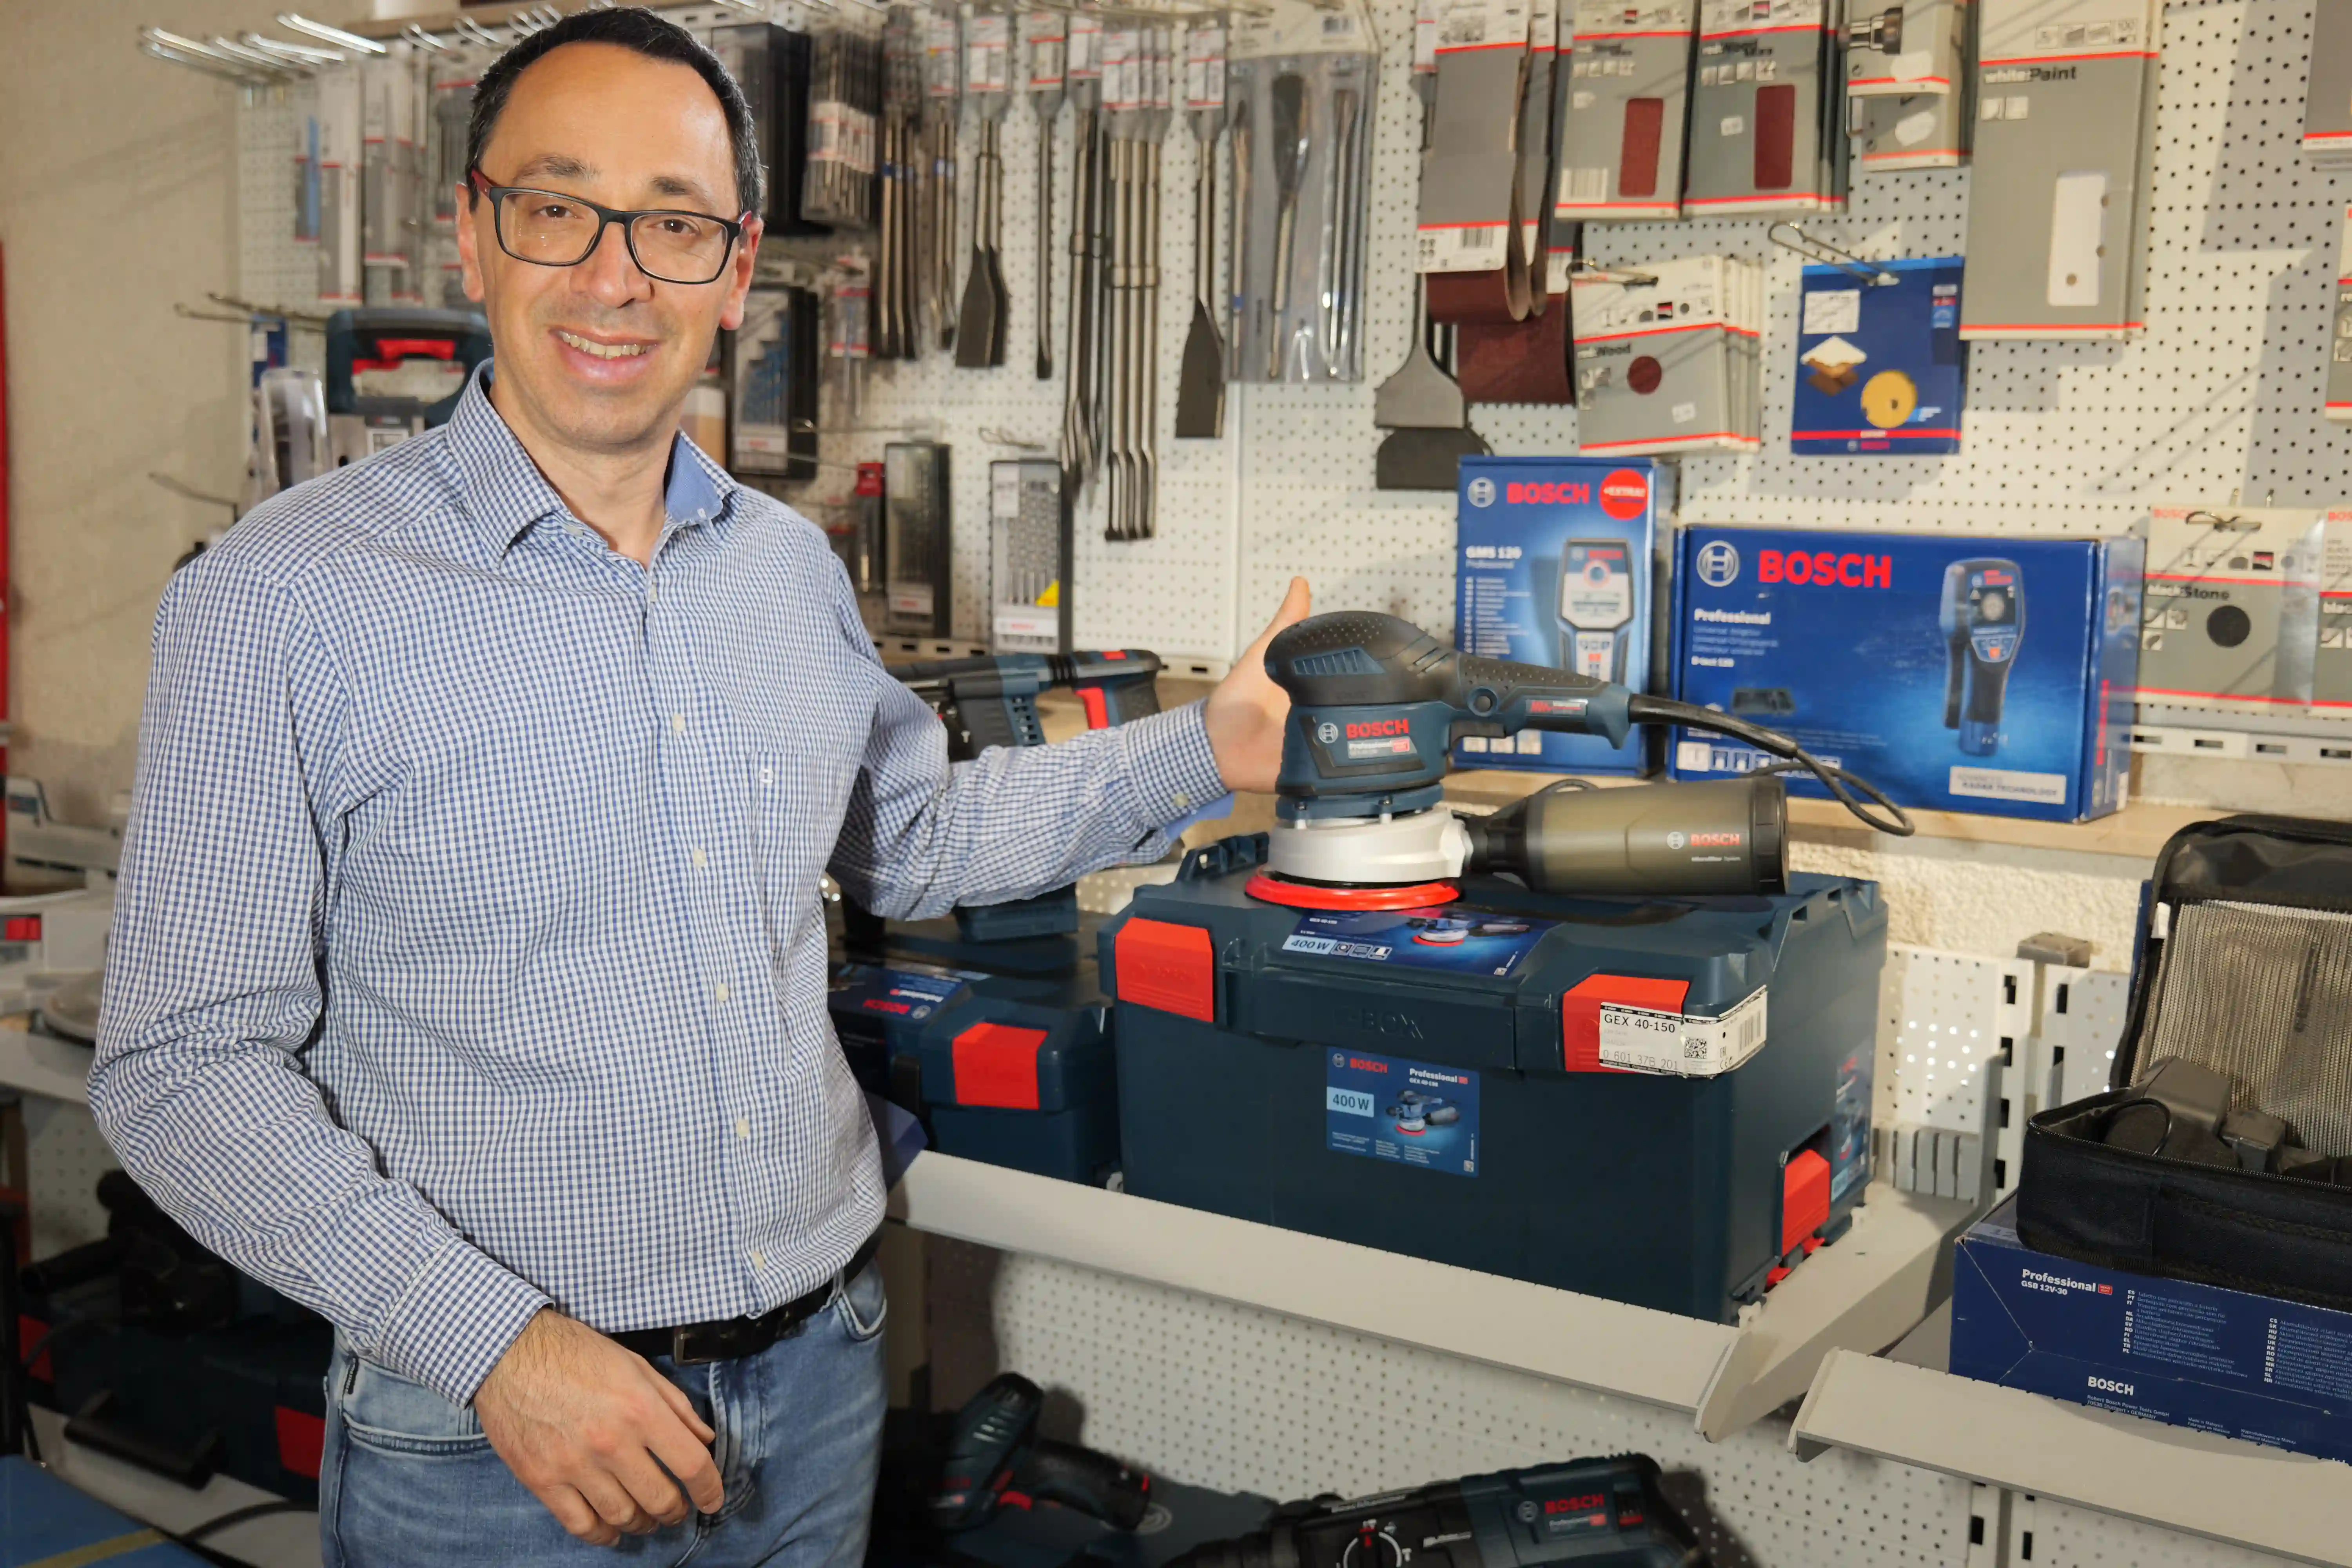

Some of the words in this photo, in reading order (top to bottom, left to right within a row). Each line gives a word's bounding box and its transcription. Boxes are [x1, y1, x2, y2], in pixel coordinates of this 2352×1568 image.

[1506, 482, 1590, 505] BOSCH
[2153, 508, 2187, 519] BOSC
[1758, 550, 1891, 588] BOSCH
[1694, 608, 1771, 625] Professional
[1346, 718, 1409, 739] BOSCH
[1690, 833, 1741, 846] BOSCH
[1291, 940, 1315, 949] 400
[1317, 941, 1331, 950] W
[1604, 1014, 1630, 1026] GEX
[1635, 1019, 1675, 1033] 40-150
[1349, 1058, 1389, 1073] BOSCH
[1603, 1049, 1609, 1059] 0
[1613, 1051, 1632, 1063] 601
[1661, 1058, 1679, 1070] 201
[1409, 1068, 1458, 1083] Professional
[1332, 1093, 1356, 1109] 400
[1358, 1097, 1369, 1111] W
[2022, 1269, 2096, 1292] Professional
[2040, 1284, 2068, 1296] 12V-30
[2088, 1376, 2134, 1396] BOSCH
[2131, 1410, 2157, 1420] GERMANY
[1544, 1493, 1605, 1514] BOSCH
